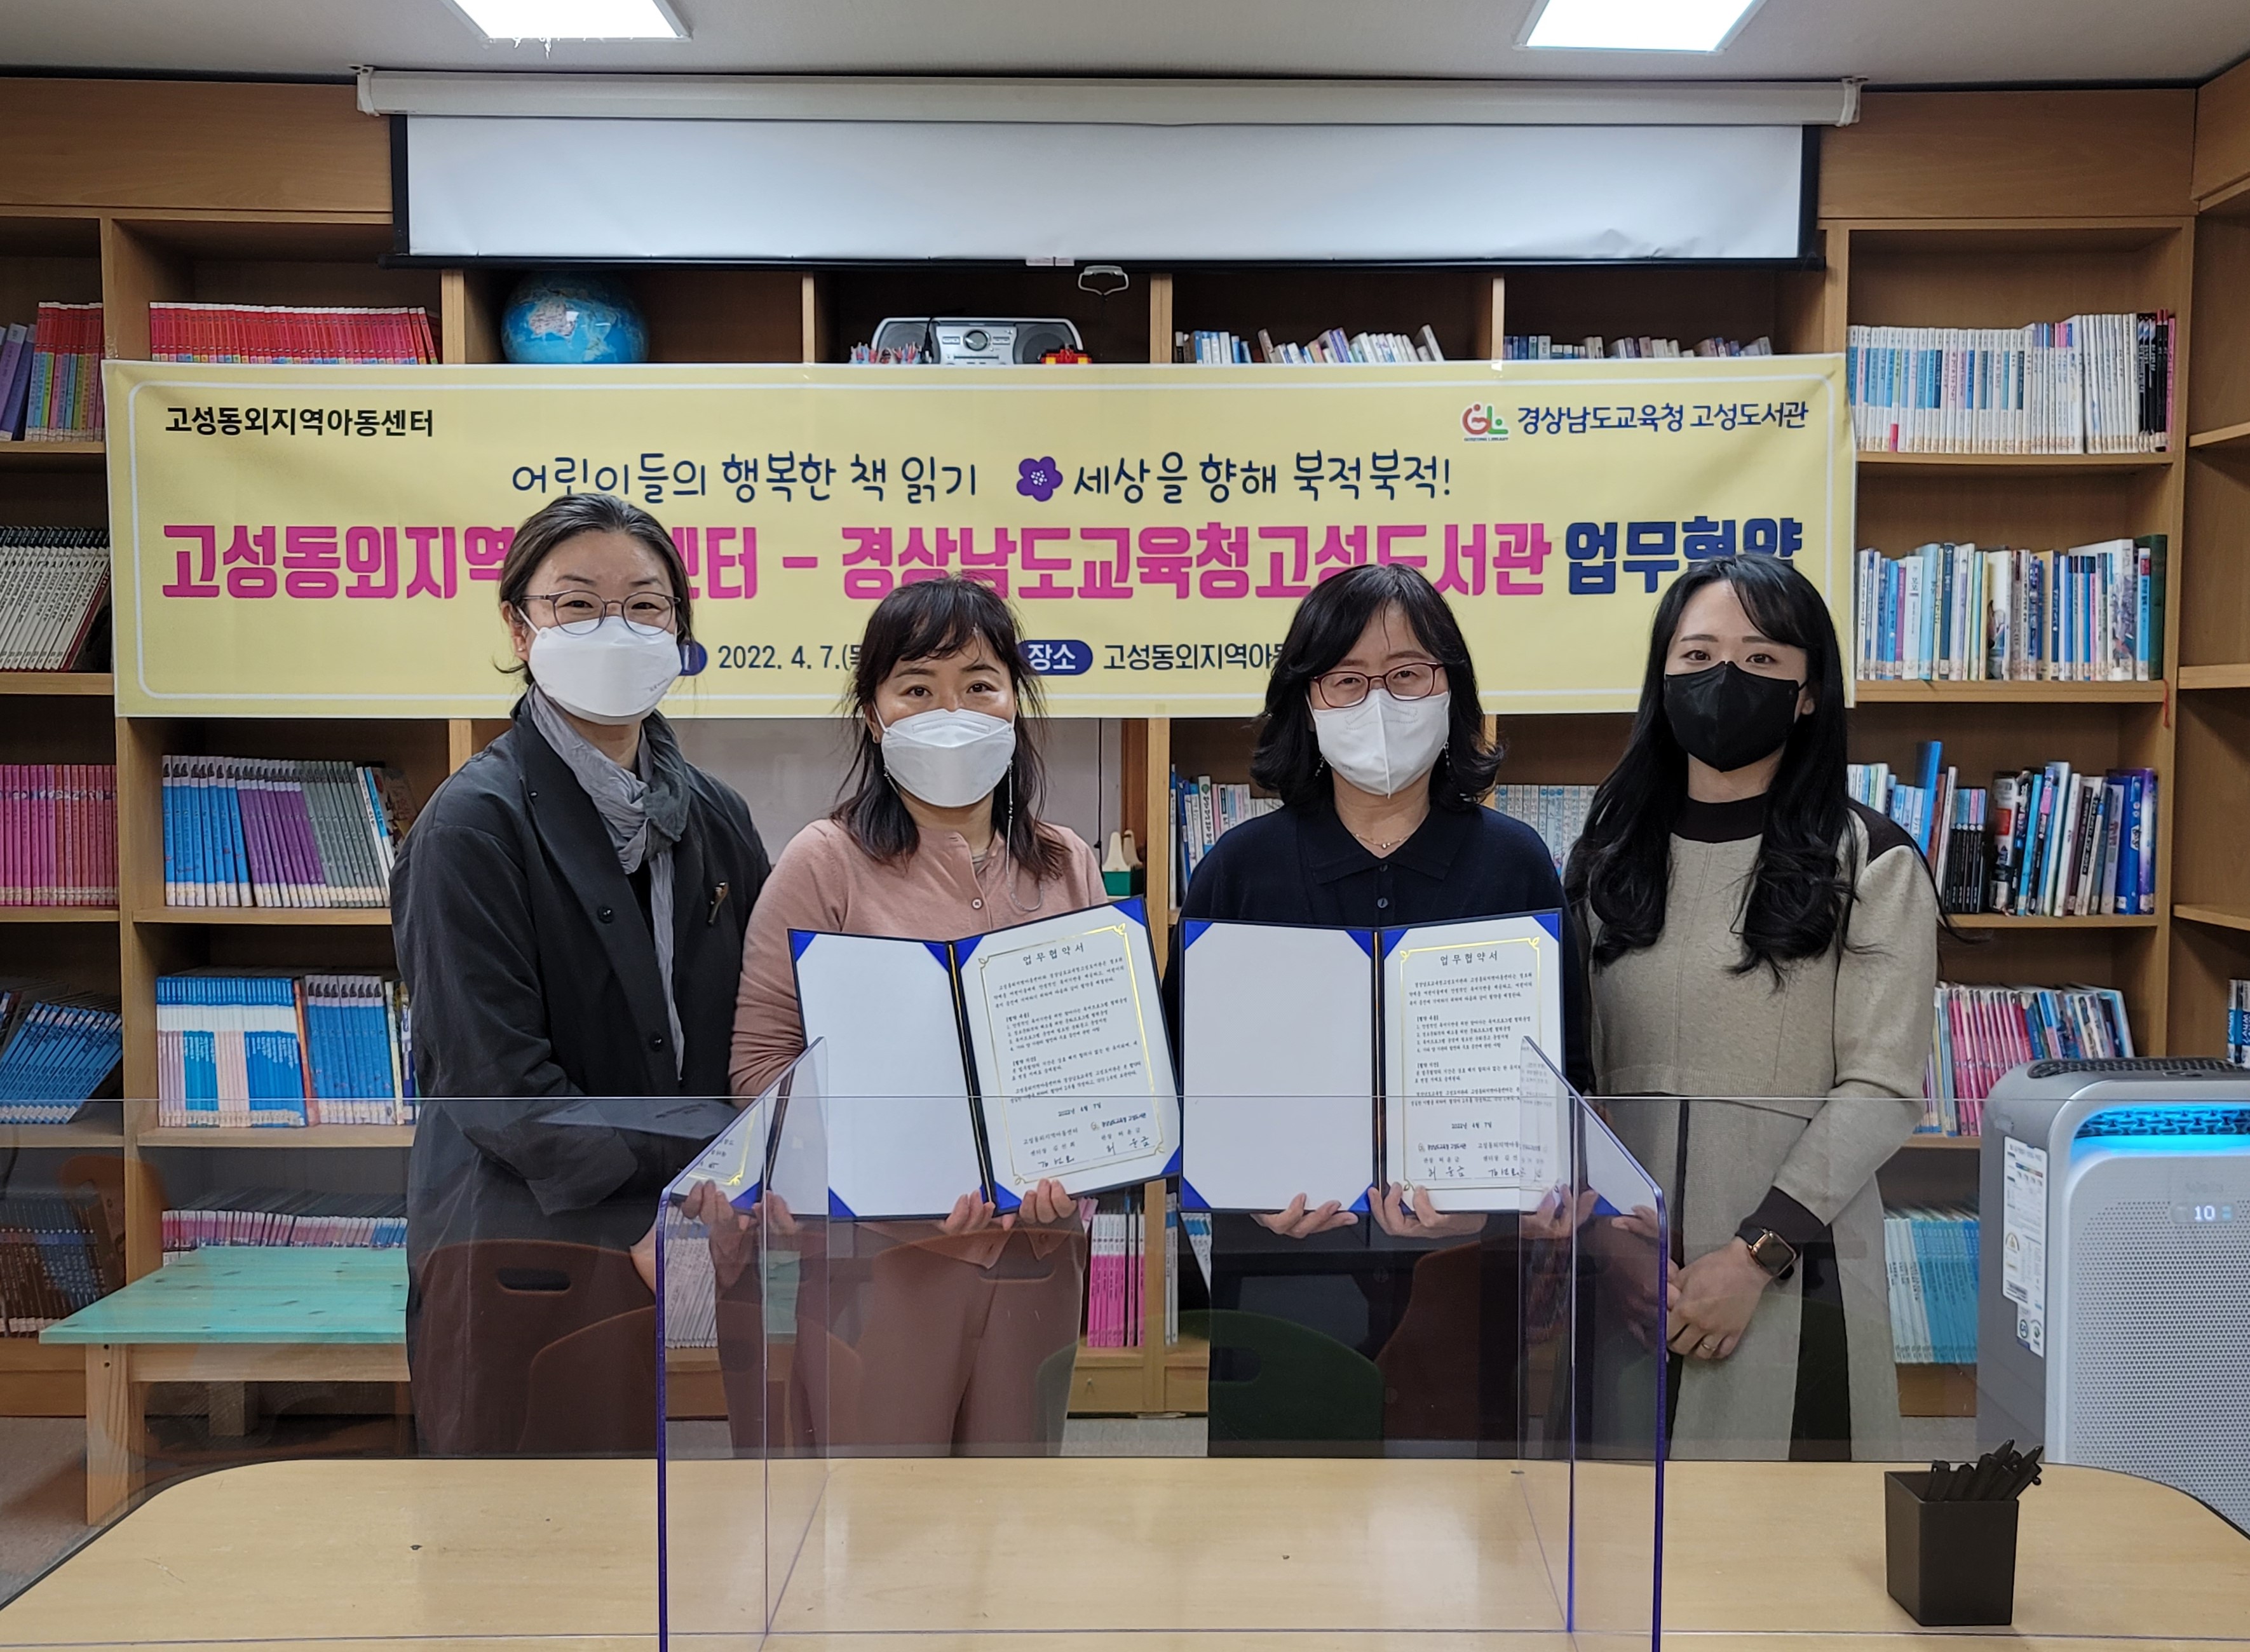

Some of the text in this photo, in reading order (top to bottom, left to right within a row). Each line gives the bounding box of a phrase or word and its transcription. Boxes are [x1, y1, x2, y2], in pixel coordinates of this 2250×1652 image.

[165, 406, 434, 437] 고성동외지역아동센터
[1517, 400, 1810, 435] 경상남도교육청 고성도서관
[512, 448, 1451, 504] 어린이들의 행복한 책 읽기 세상을 향해 북적북적!
[842, 522, 1552, 600] 경상남도교육청고성도서관
[718, 646, 782, 669] 2022.
[791, 646, 812, 669] 4.
[1027, 643, 1076, 671] 장소
[2195, 1205, 2215, 1221] 10
